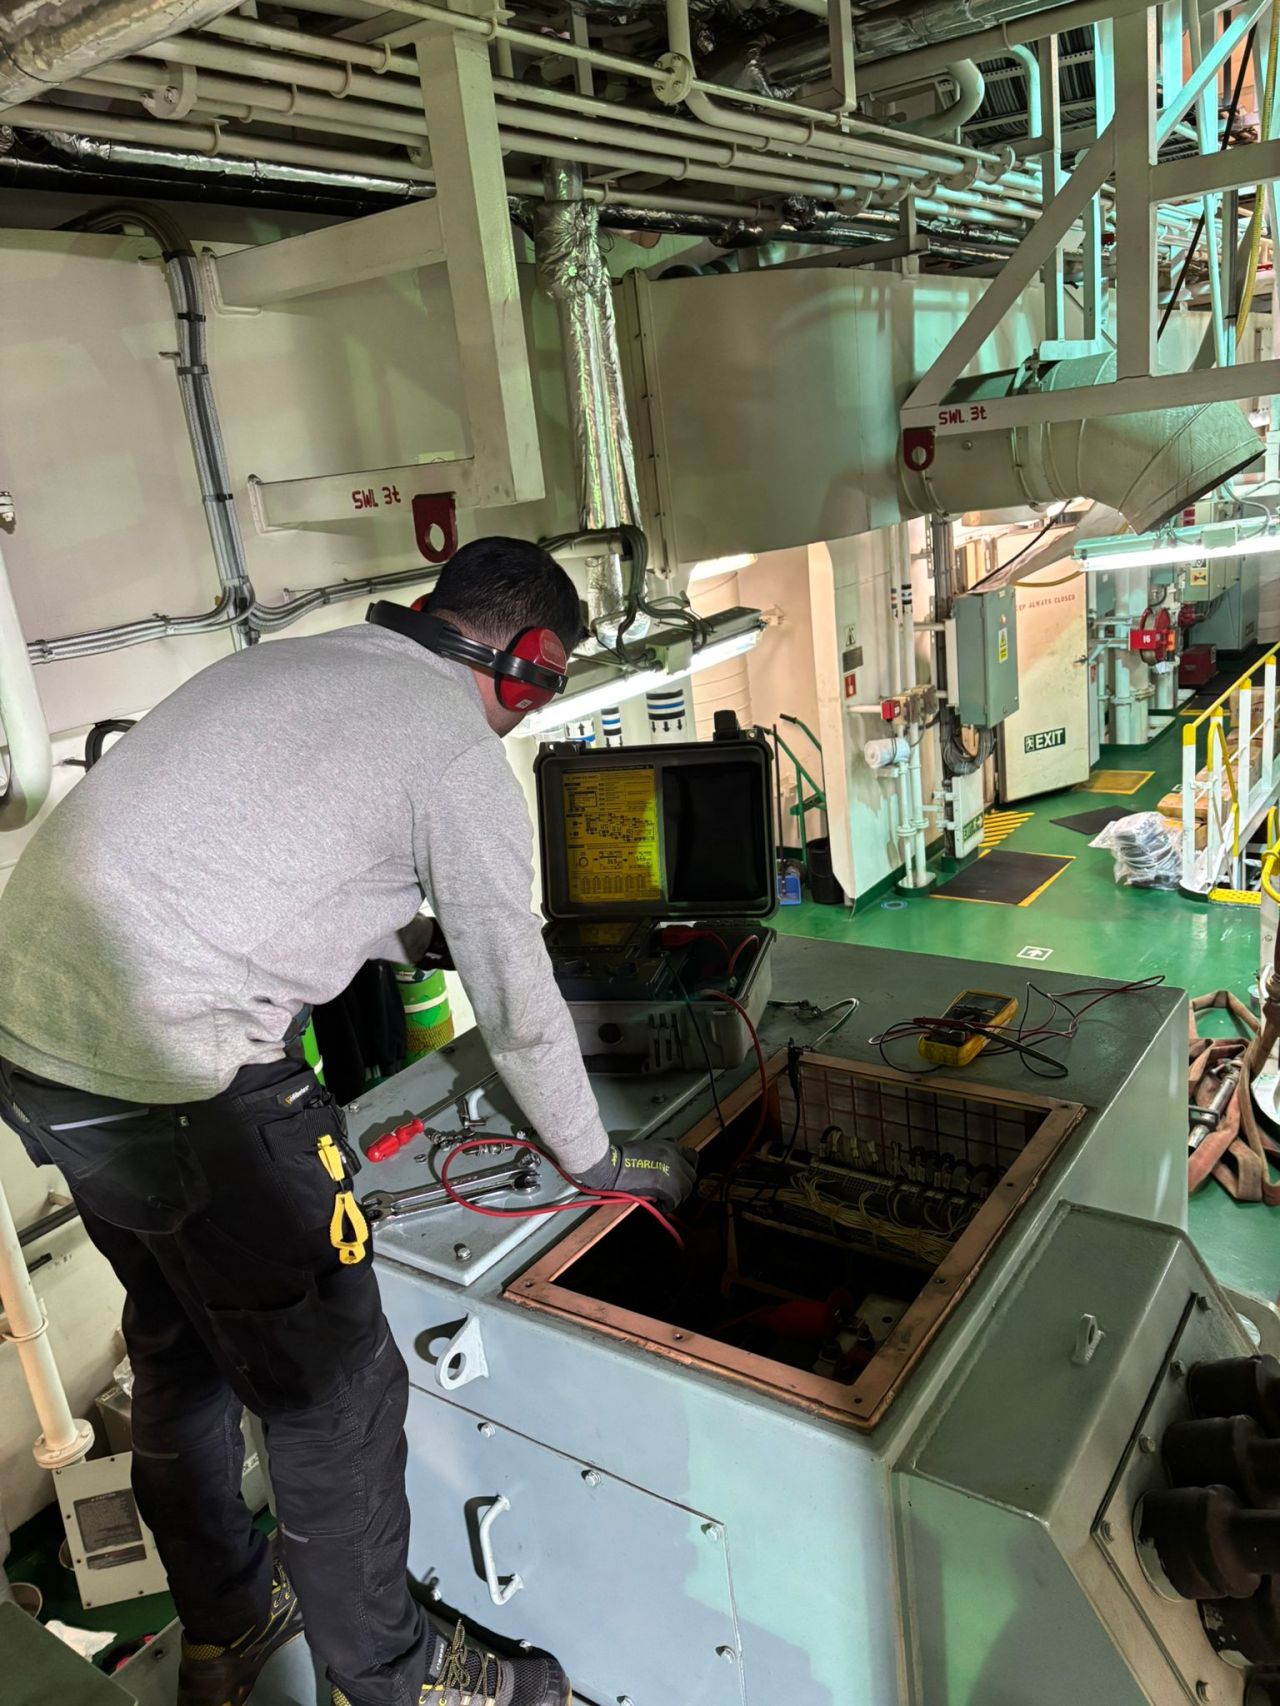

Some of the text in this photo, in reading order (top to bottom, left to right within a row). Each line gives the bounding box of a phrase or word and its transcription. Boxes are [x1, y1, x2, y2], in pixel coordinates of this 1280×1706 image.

[969, 405, 988, 421] 3t
[351, 484, 402, 509] SWL 3t
[1029, 597, 1052, 609] ALWAYS
[1054, 593, 1076, 604] CLOSED
[1035, 729, 1063, 749] EXIT
[624, 1158, 671, 1177] STARLINE
